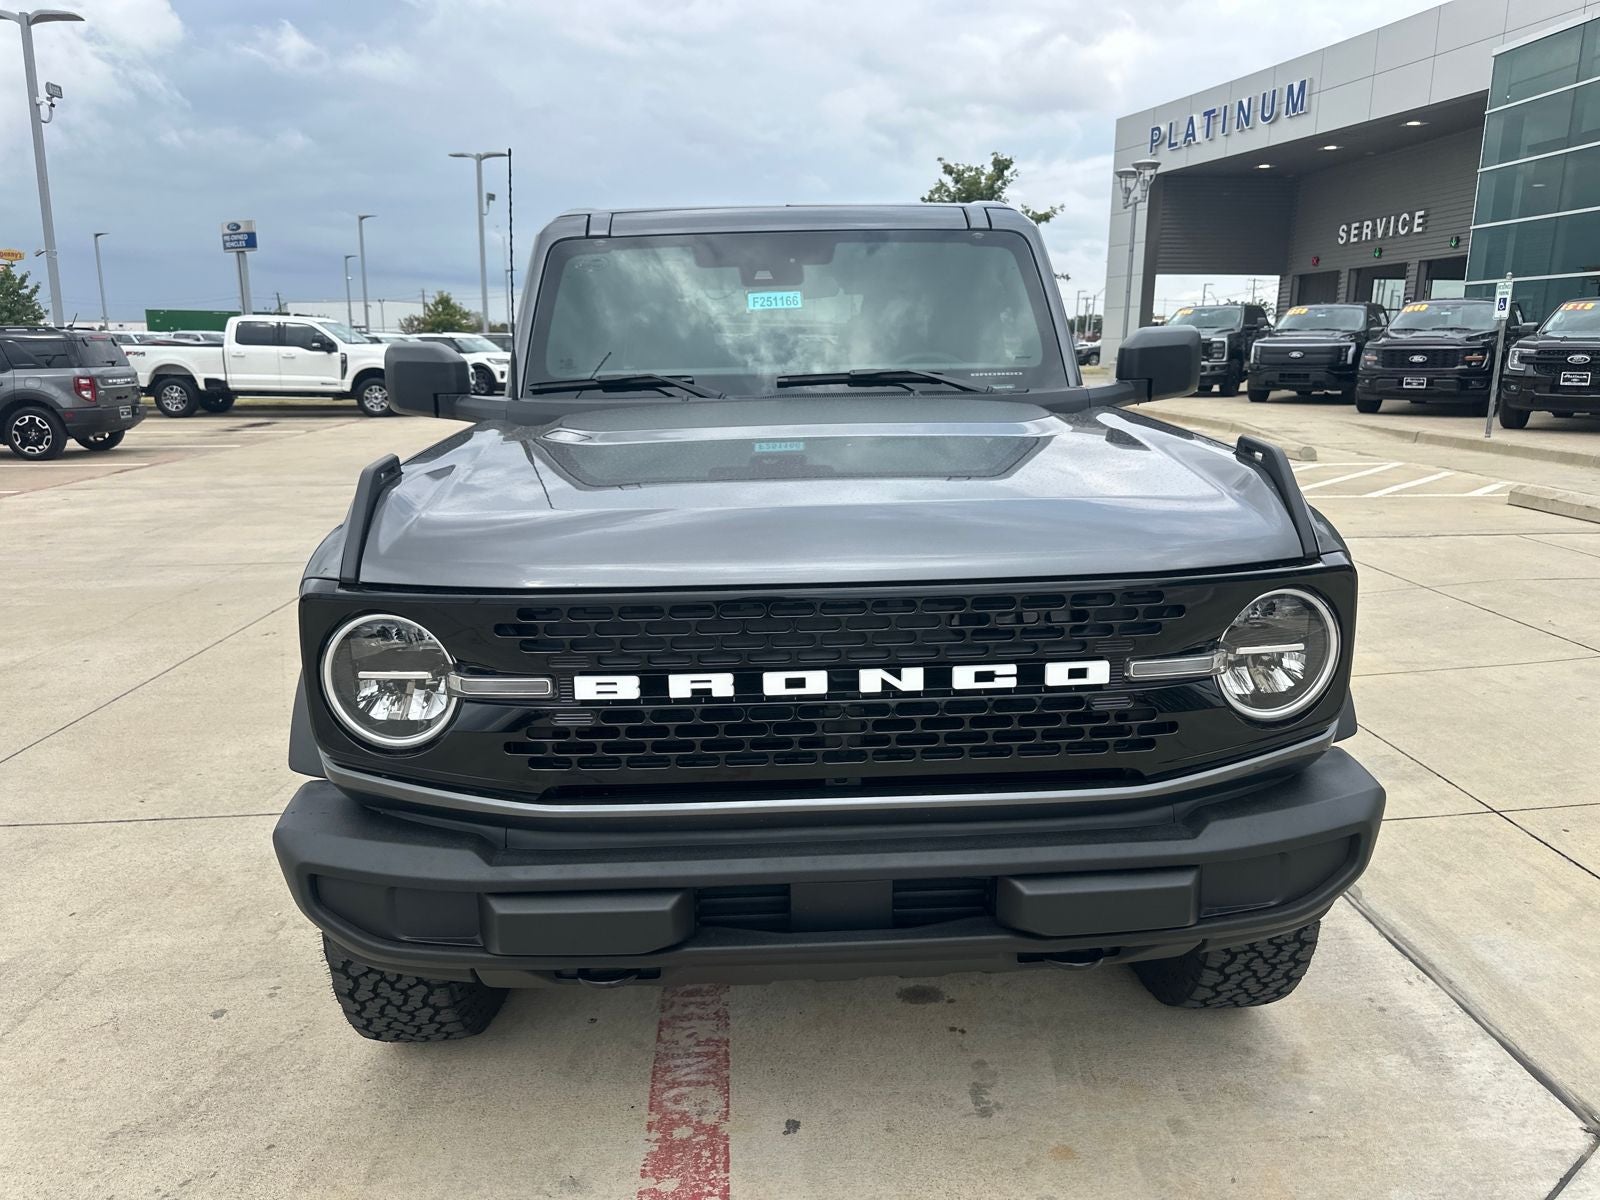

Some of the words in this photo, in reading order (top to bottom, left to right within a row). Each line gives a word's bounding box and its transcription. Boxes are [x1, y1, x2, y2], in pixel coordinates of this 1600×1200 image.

[1148, 77, 1310, 155] PLATINUM
[1337, 210, 1425, 245] SERVICE
[752, 295, 800, 308] F251166
[573, 659, 1111, 701] BRONCO
